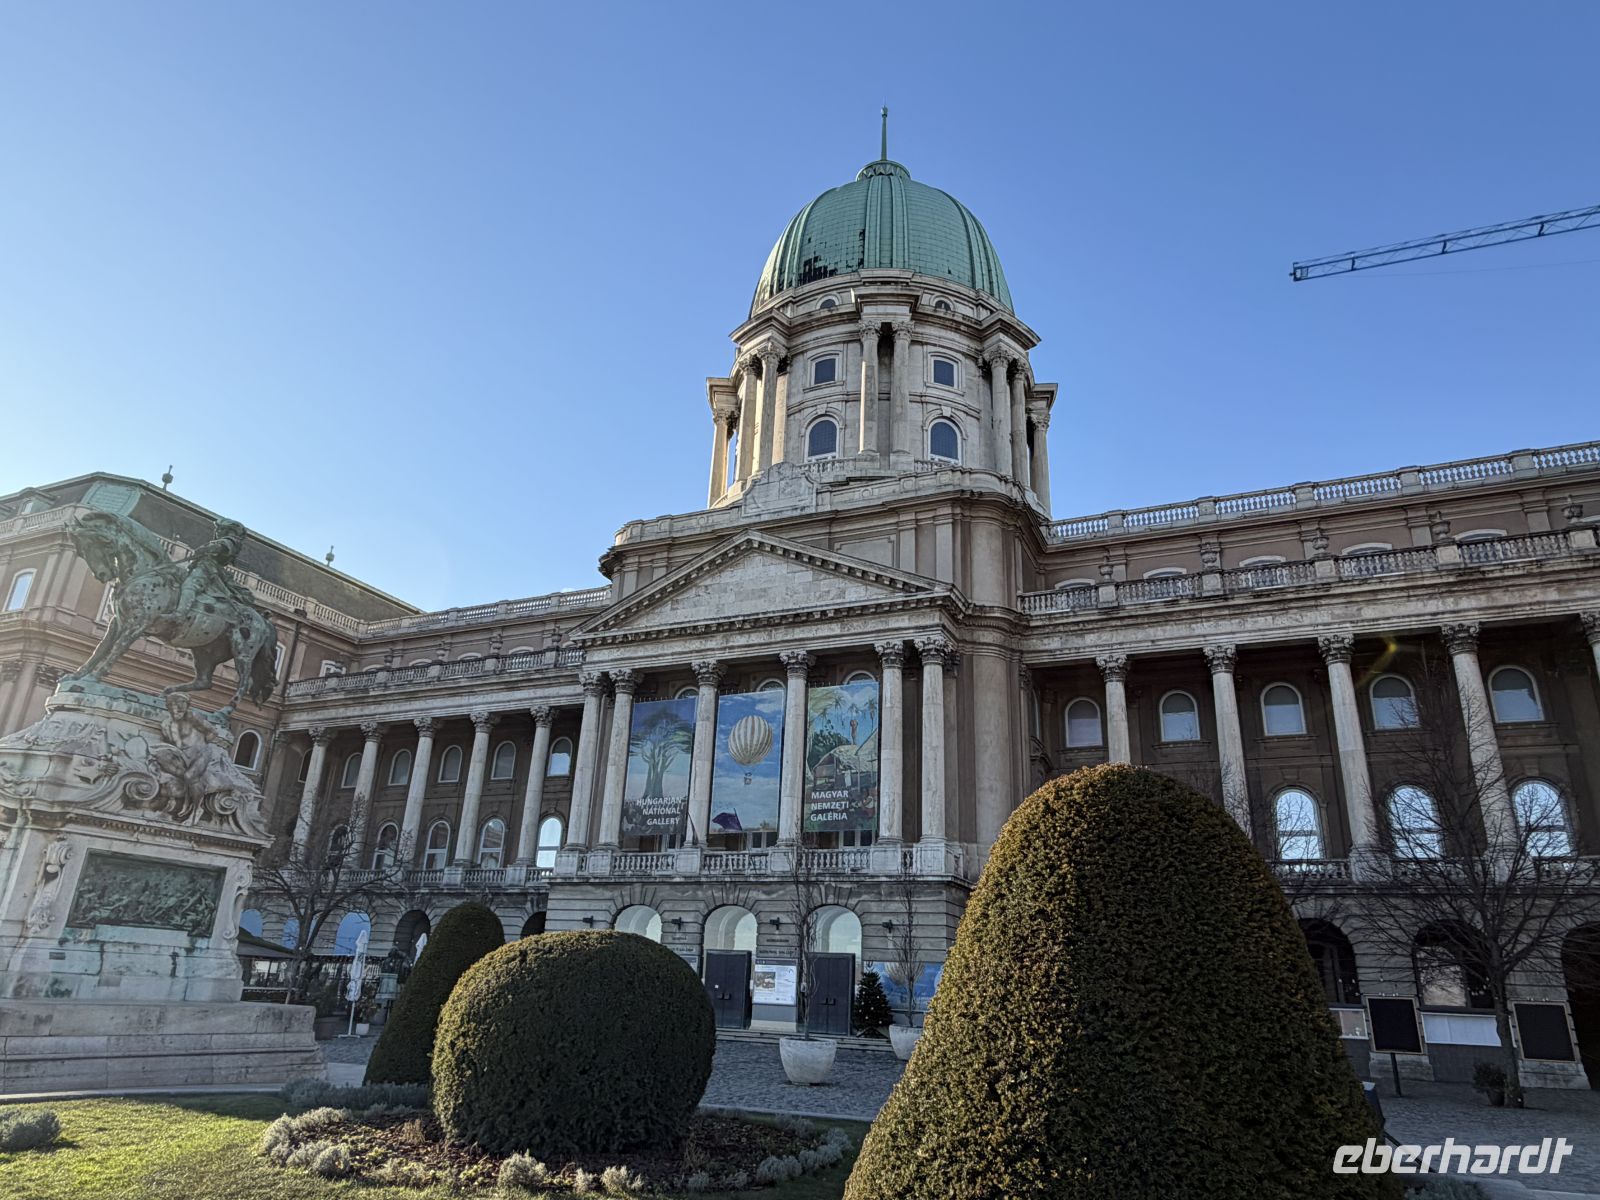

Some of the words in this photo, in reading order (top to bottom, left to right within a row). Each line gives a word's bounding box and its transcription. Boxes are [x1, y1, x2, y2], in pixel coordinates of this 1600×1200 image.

[811, 790, 849, 799] MAGYAR
[636, 796, 682, 806] HUNGARIAN
[811, 801, 849, 810] NEMZETI
[642, 806, 681, 815] NATIONAL
[810, 811, 848, 822] GALÉRIA
[646, 817, 680, 826] GALLERY
